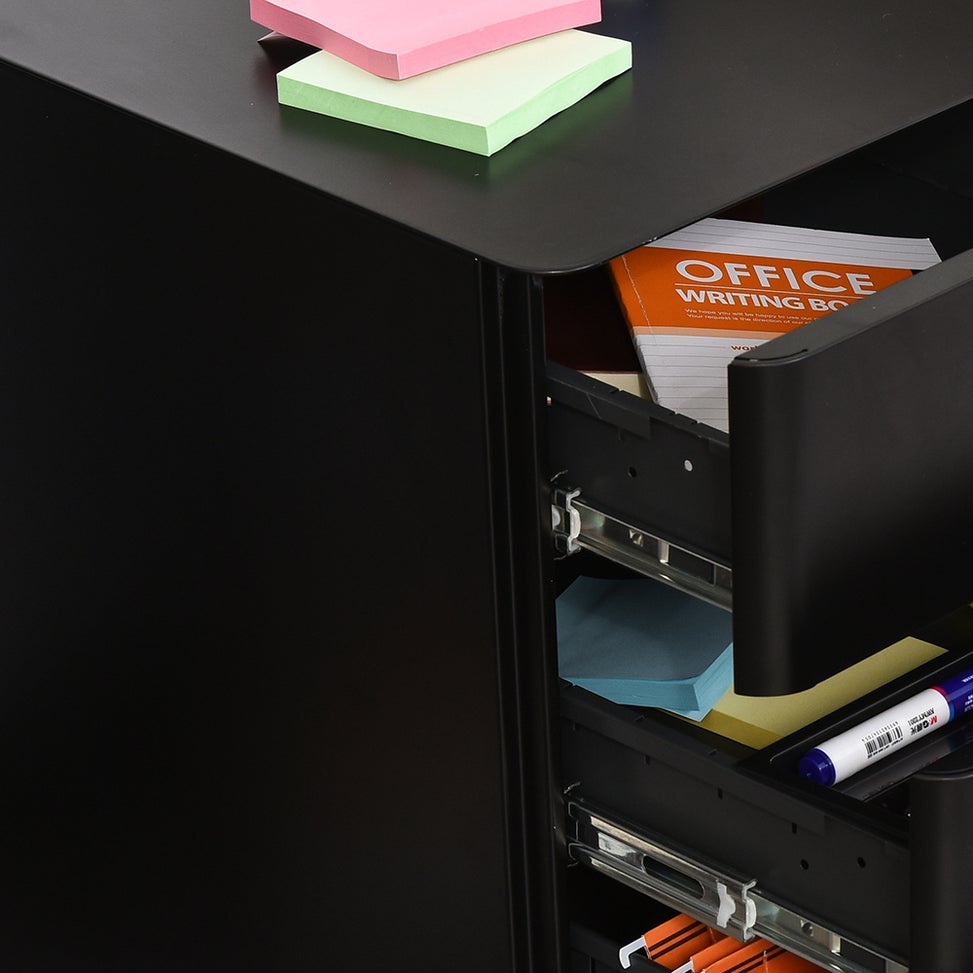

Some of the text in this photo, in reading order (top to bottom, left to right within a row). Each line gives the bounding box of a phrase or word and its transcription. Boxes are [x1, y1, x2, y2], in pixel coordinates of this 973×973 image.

[675, 259, 877, 295] OFFICE
[675, 288, 849, 312] WRITING BO
